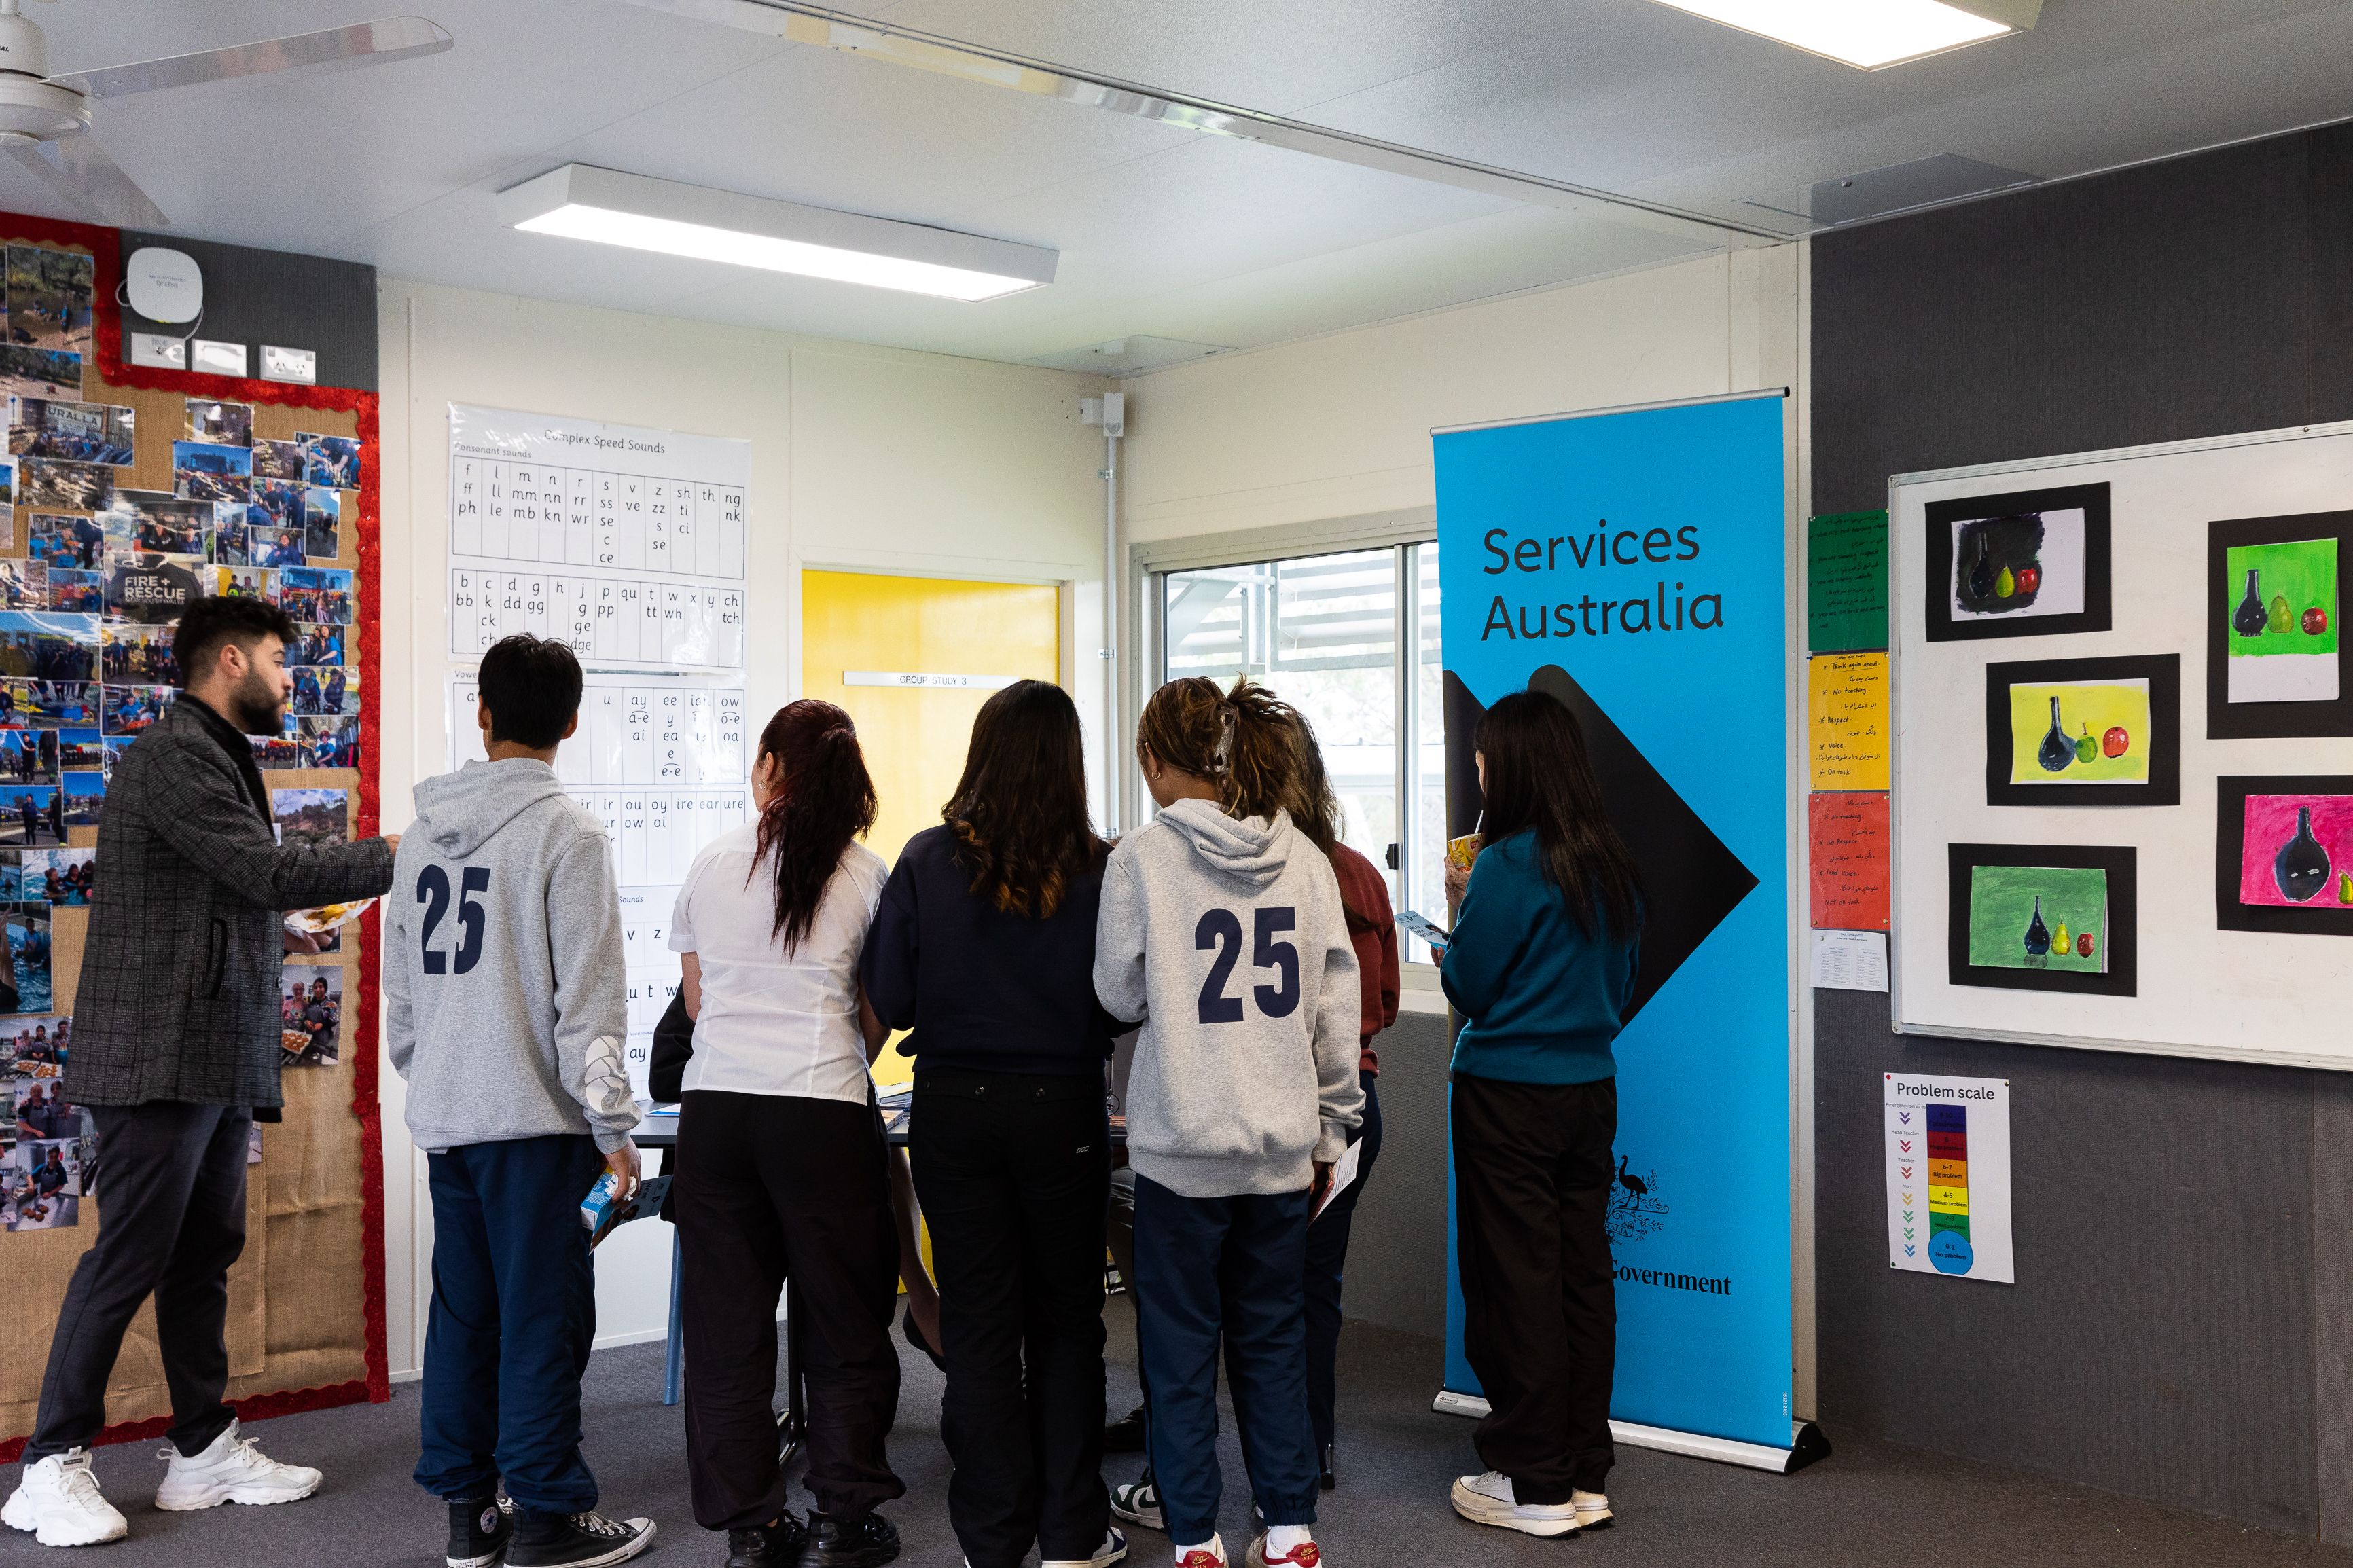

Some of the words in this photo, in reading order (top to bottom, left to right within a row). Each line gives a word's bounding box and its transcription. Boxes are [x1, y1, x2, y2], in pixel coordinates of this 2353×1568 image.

[48, 407, 98, 426] URALLA
[544, 429, 590, 445] Complex
[594, 435, 624, 450] Speed
[628, 439, 665, 454] Sounds
[502, 449, 532, 459] sounds
[465, 463, 471, 476] f
[518, 472, 531, 483] m
[548, 475, 557, 486] n
[577, 478, 583, 488] r
[603, 481, 609, 491] s
[629, 484, 636, 494] v
[655, 486, 662, 496] z
[677, 486, 691, 499] sh
[702, 488, 715, 502] th
[725, 494, 740, 509] ng
[463, 481, 473, 494] ff
[492, 484, 501, 498] ll
[511, 490, 537, 502] mm
[543, 493, 562, 504] nn
[574, 496, 587, 506] rr
[600, 498, 613, 509] ss
[626, 501, 641, 512] ve
[651, 504, 666, 514] zz
[679, 505, 689, 517] ti
[725, 509, 740, 522] nk
[458, 500, 477, 517] ph
[490, 502, 503, 517] le
[514, 505, 536, 519] mb
[544, 507, 561, 522] kn
[571, 514, 590, 524] wr
[600, 517, 614, 527] se
[656, 522, 662, 532] s
[679, 522, 689, 534] ci
[603, 536, 610, 545] c
[653, 541, 666, 551] se
[1483, 518, 1700, 575] Services
[599, 553, 614, 564] ce
[125, 576, 159, 586] FIRE
[124, 588, 186, 600] RESCUE
[461, 573, 469, 588] b
[485, 579, 492, 589] c
[508, 577, 517, 591] d
[532, 583, 540, 596] g
[556, 579, 564, 594] h
[579, 583, 585, 600] j
[602, 587, 610, 600] p
[620, 589, 637, 602] qu
[649, 588, 654, 600] t
[668, 592, 679, 602] w
[690, 594, 697, 604] x
[708, 596, 715, 608] y
[724, 594, 738, 607] ch
[456, 592, 473, 607] bb
[484, 594, 492, 608] k
[503, 596, 522, 610] dd
[527, 600, 544, 615] gg
[579, 604, 587, 617] g
[597, 605, 615, 619] pp
[646, 606, 658, 618] tt
[664, 606, 682, 620] wh
[722, 611, 740, 625] tch
[1481, 581, 1725, 642] Australia
[480, 613, 497, 627] ck
[574, 621, 591, 636] ge
[481, 634, 497, 645] ch
[571, 638, 591, 652] dge
[454, 670, 477, 678] Vowe
[899, 675, 927, 685] GROUP
[932, 676, 958, 685] STUDY
[961, 676, 967, 686] 3
[467, 693, 475, 702] a
[603, 695, 611, 706] u
[631, 696, 647, 710] ay
[663, 697, 677, 706] ee
[721, 697, 740, 707] ow
[628, 710, 649, 723] a-e
[667, 714, 674, 728] y
[721, 711, 740, 725] o-e
[632, 729, 645, 742] ai
[663, 732, 679, 742] ea
[723, 732, 739, 742] oa
[668, 750, 675, 759] e
[661, 763, 681, 777] e-e
[603, 798, 613, 811] ir
[626, 801, 642, 811] ou
[651, 801, 667, 814] oy
[677, 798, 694, 810] ire
[699, 800, 720, 809] ear
[723, 800, 744, 809] ure
[624, 819, 643, 828] ow
[653, 818, 666, 828] oi
[416, 864, 492, 975] 25
[1194, 906, 1301, 1024] 25
[647, 985, 653, 998] t
[629, 1047, 646, 1063] ay
[1897, 1083, 1954, 1098] Problem
[1958, 1087, 1994, 1099] scale
